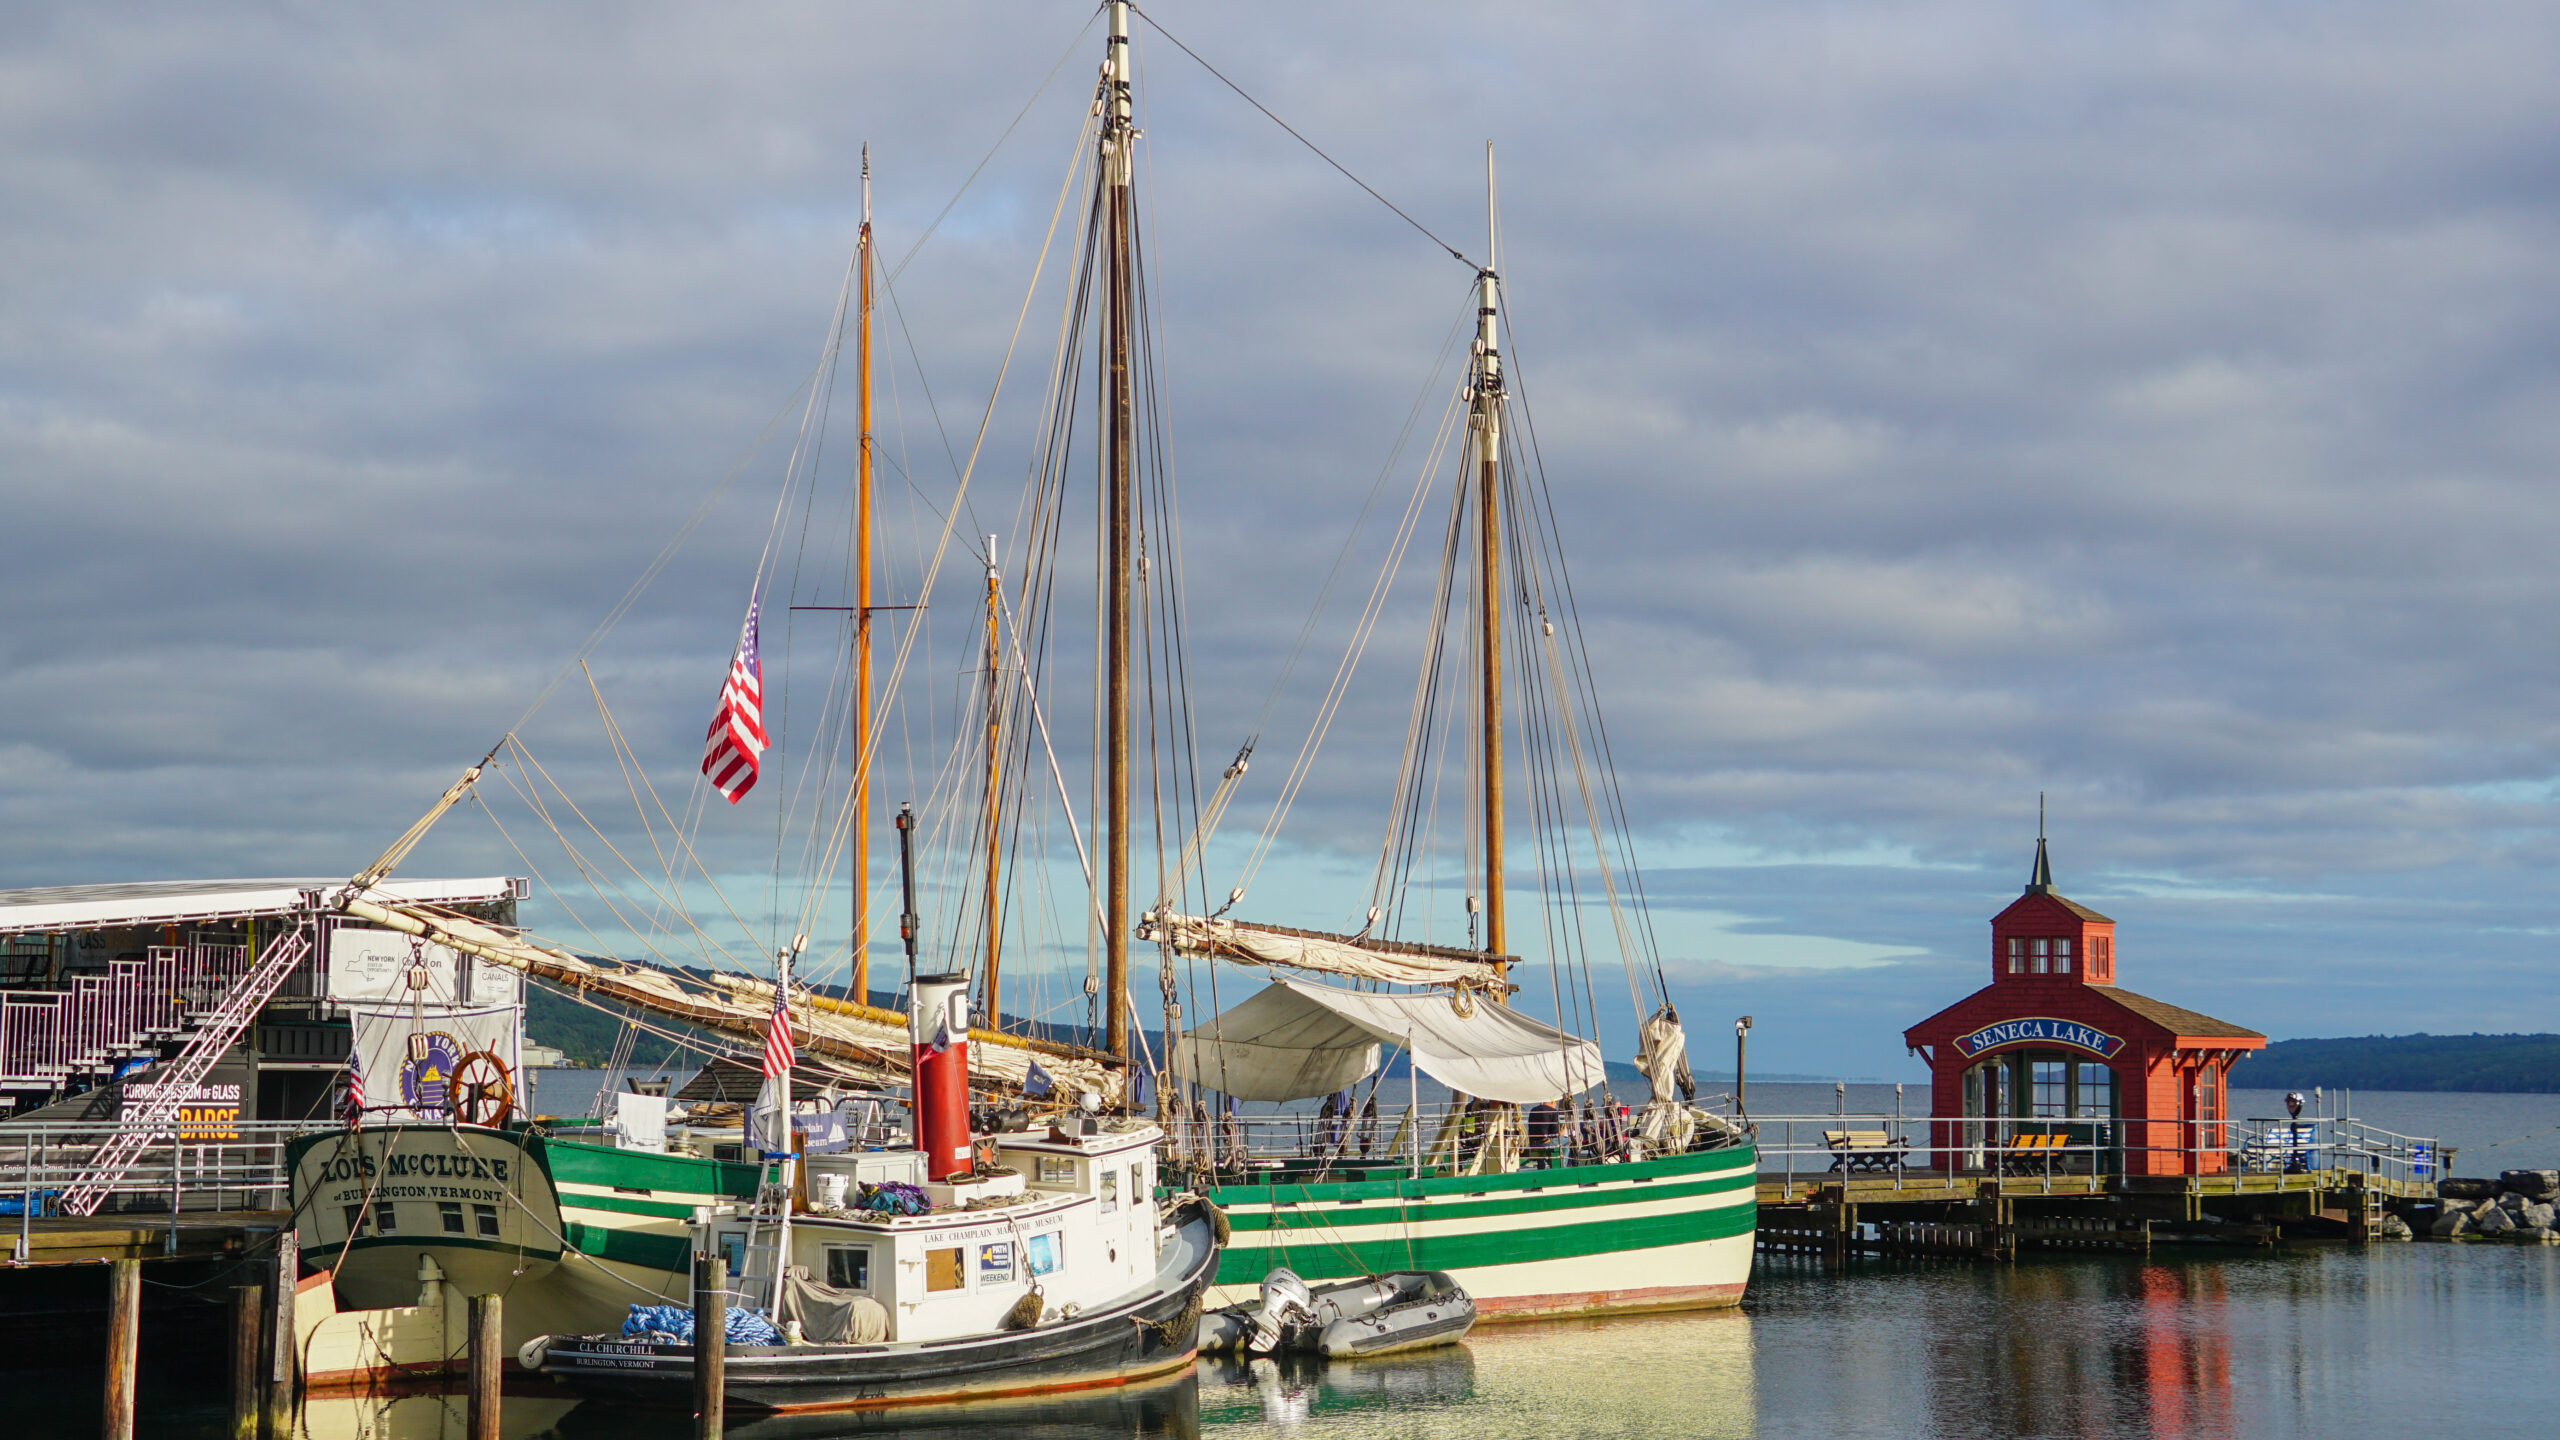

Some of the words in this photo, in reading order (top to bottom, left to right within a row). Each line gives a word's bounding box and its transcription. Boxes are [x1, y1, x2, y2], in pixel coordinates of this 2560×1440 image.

[380, 955, 395, 963] YORK
[402, 957, 428, 967] Coucil
[481, 972, 509, 982] CANALS
[1972, 1021, 2044, 1050] SENECA
[2051, 1022, 2105, 1050] LAKE
[434, 1035, 460, 1066] YORK
[123, 1083, 163, 1099] CORNING
[212, 1084, 240, 1100] GLASS
[4, 1164, 42, 1176] Enginering
[321, 1155, 376, 1182] LOIS
[924, 1232, 944, 1243] LAKE
[949, 1229, 992, 1241] CHAMPLAIN
[996, 1222, 1030, 1235] MARIIME
[1034, 1215, 1064, 1227] MUSEUM
[981, 1273, 1009, 1282] WEEKEND
[580, 1343, 594, 1353] C.L.
[596, 1344, 655, 1355] CHURCHILL
[577, 1358, 618, 1368] BURLINGTON,
